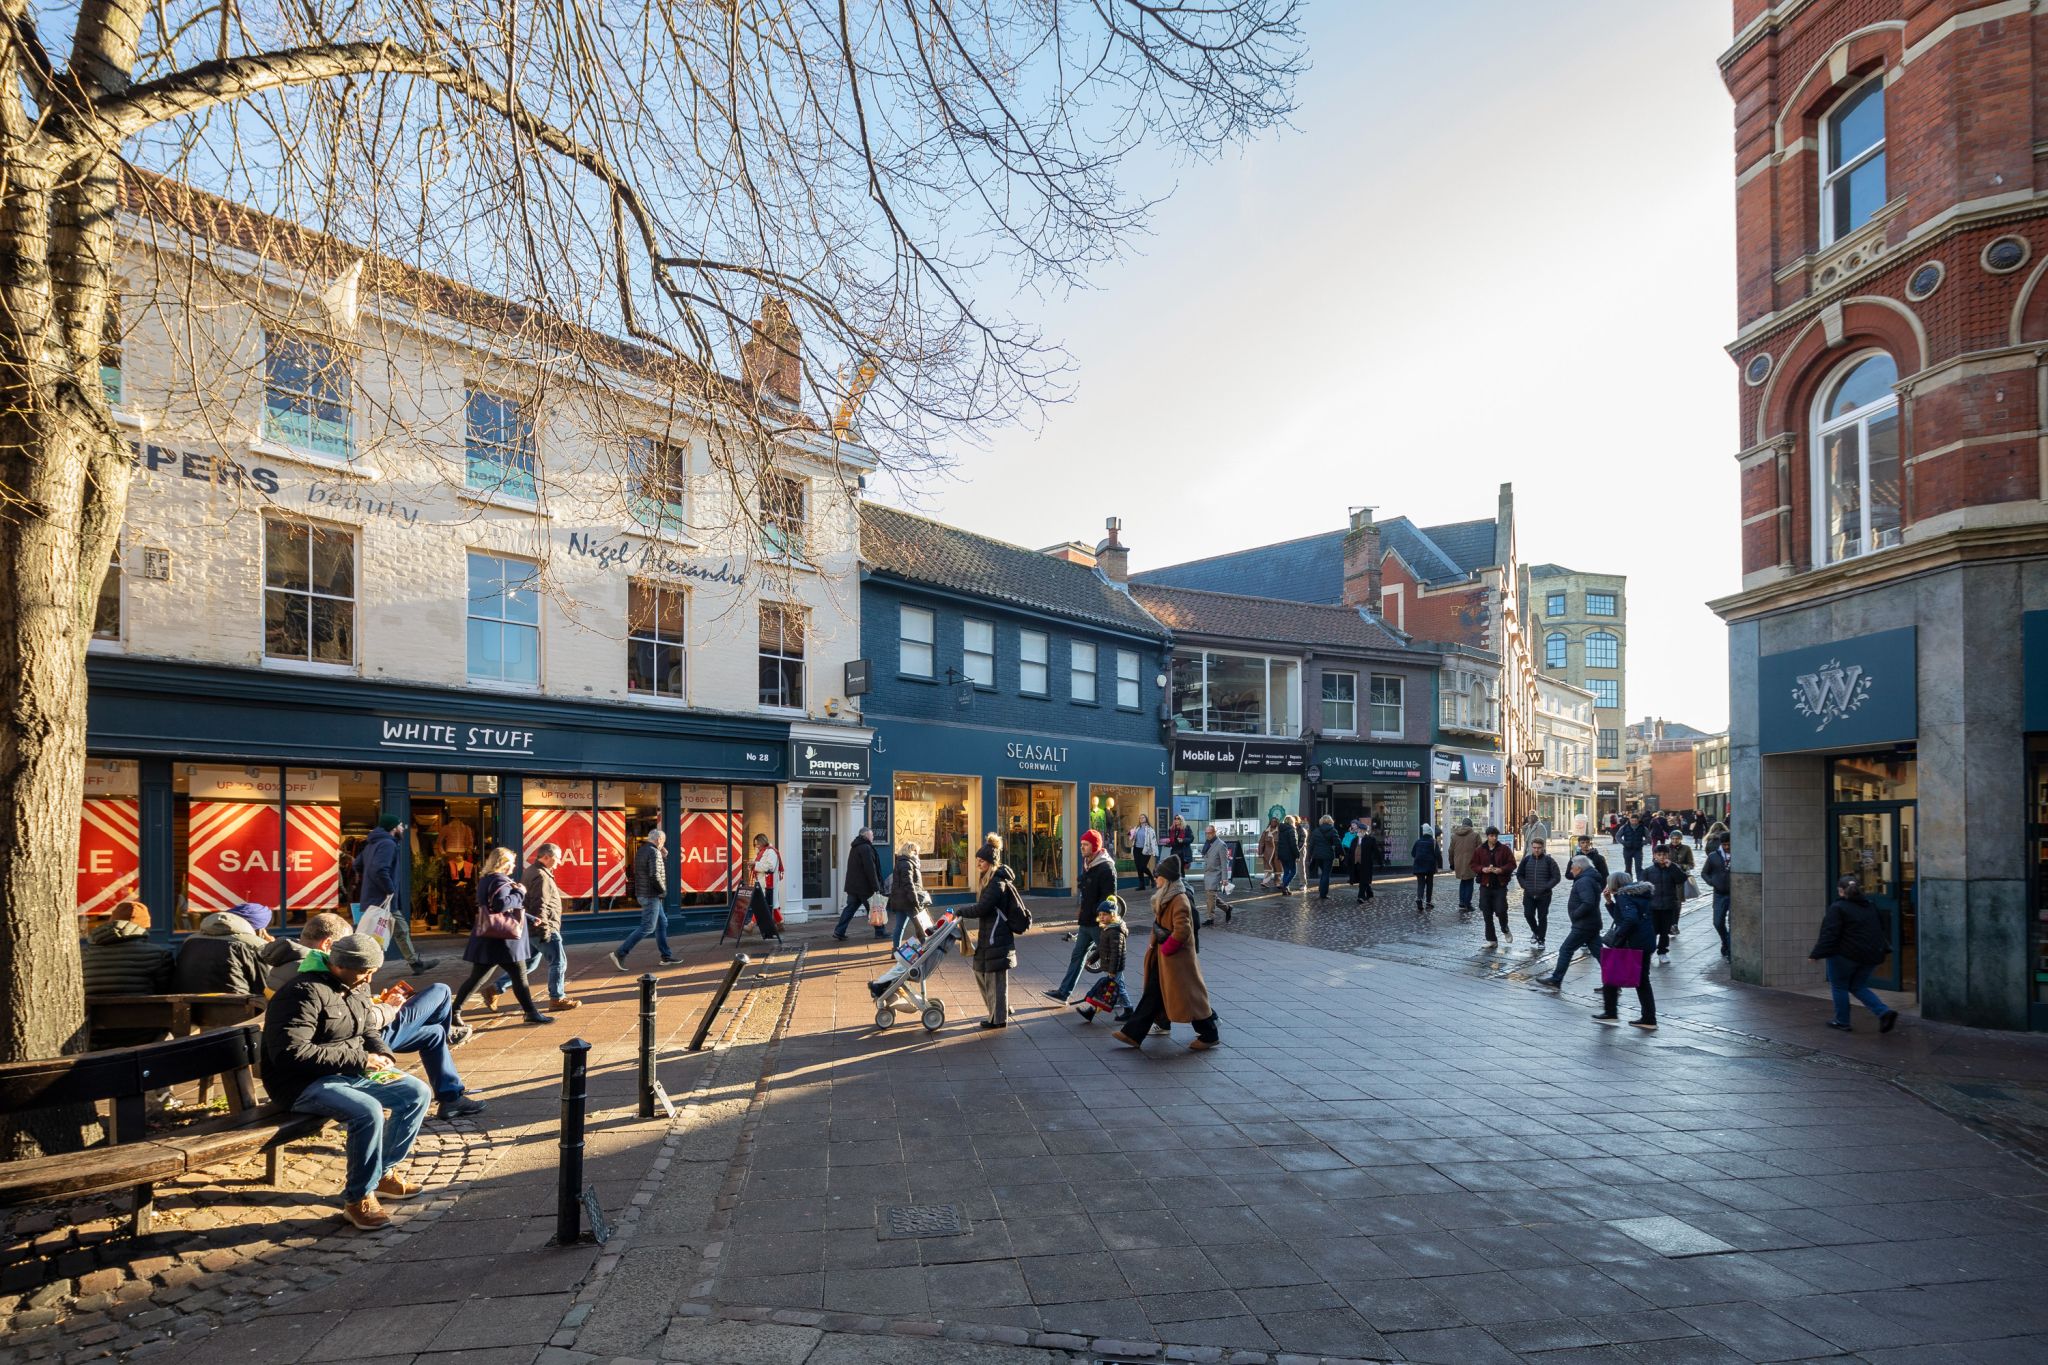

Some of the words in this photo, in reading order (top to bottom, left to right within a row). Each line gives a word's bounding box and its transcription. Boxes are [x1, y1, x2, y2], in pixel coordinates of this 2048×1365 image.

[308, 481, 418, 529] beauty
[567, 532, 629, 569] Nigel
[1797, 665, 1862, 715] W
[384, 720, 457, 744] WHITE
[467, 727, 534, 748] STUFF
[746, 752, 757, 761] No
[759, 753, 769, 762] 28
[1007, 742, 1069, 762] SEASALT
[1182, 750, 1215, 761] Mobile
[1217, 751, 1235, 762] Lab
[1527, 752, 1542, 762] W
[809, 760, 860, 771] pampers
[1019, 761, 1059, 772] CORNWALL
[1331, 757, 1369, 767] VINTAGE
[1372, 758, 1412, 769] EMPORIUM
[84, 776, 105, 785] FF
[541, 791, 553, 799] UP
[1384, 806, 1408, 814] NEED
[895, 819, 928, 836] SALE
[218, 850, 313, 872] SALE
[559, 848, 608, 866] ALE
